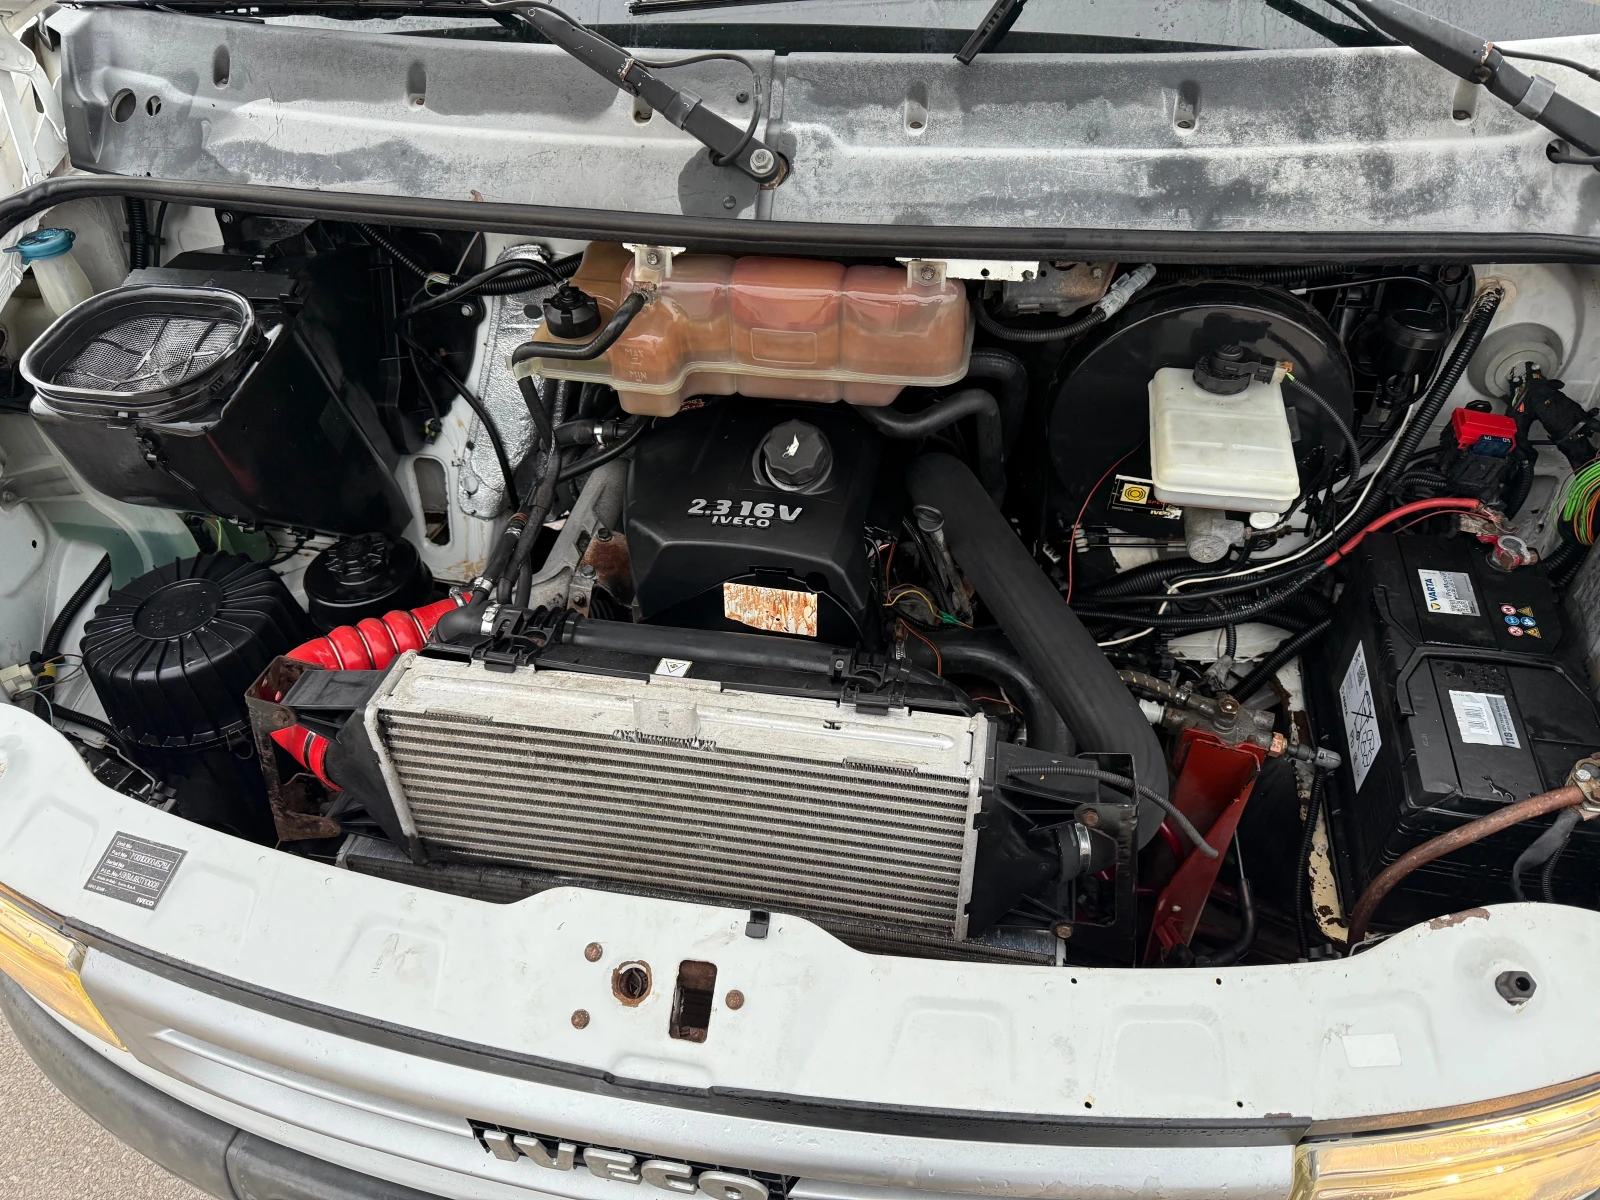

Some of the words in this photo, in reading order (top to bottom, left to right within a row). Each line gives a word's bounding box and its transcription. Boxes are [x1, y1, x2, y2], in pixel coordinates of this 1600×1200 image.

[624, 348, 644, 358] MAX
[629, 371, 648, 380] MIN
[687, 498, 732, 516] 2.3
[739, 500, 803, 521] 16V
[711, 515, 771, 528] IVECO
[1424, 578, 1438, 601] VARTA
[136, 896, 155, 907] IVECO
[483, 1129, 770, 1200] IVECO
